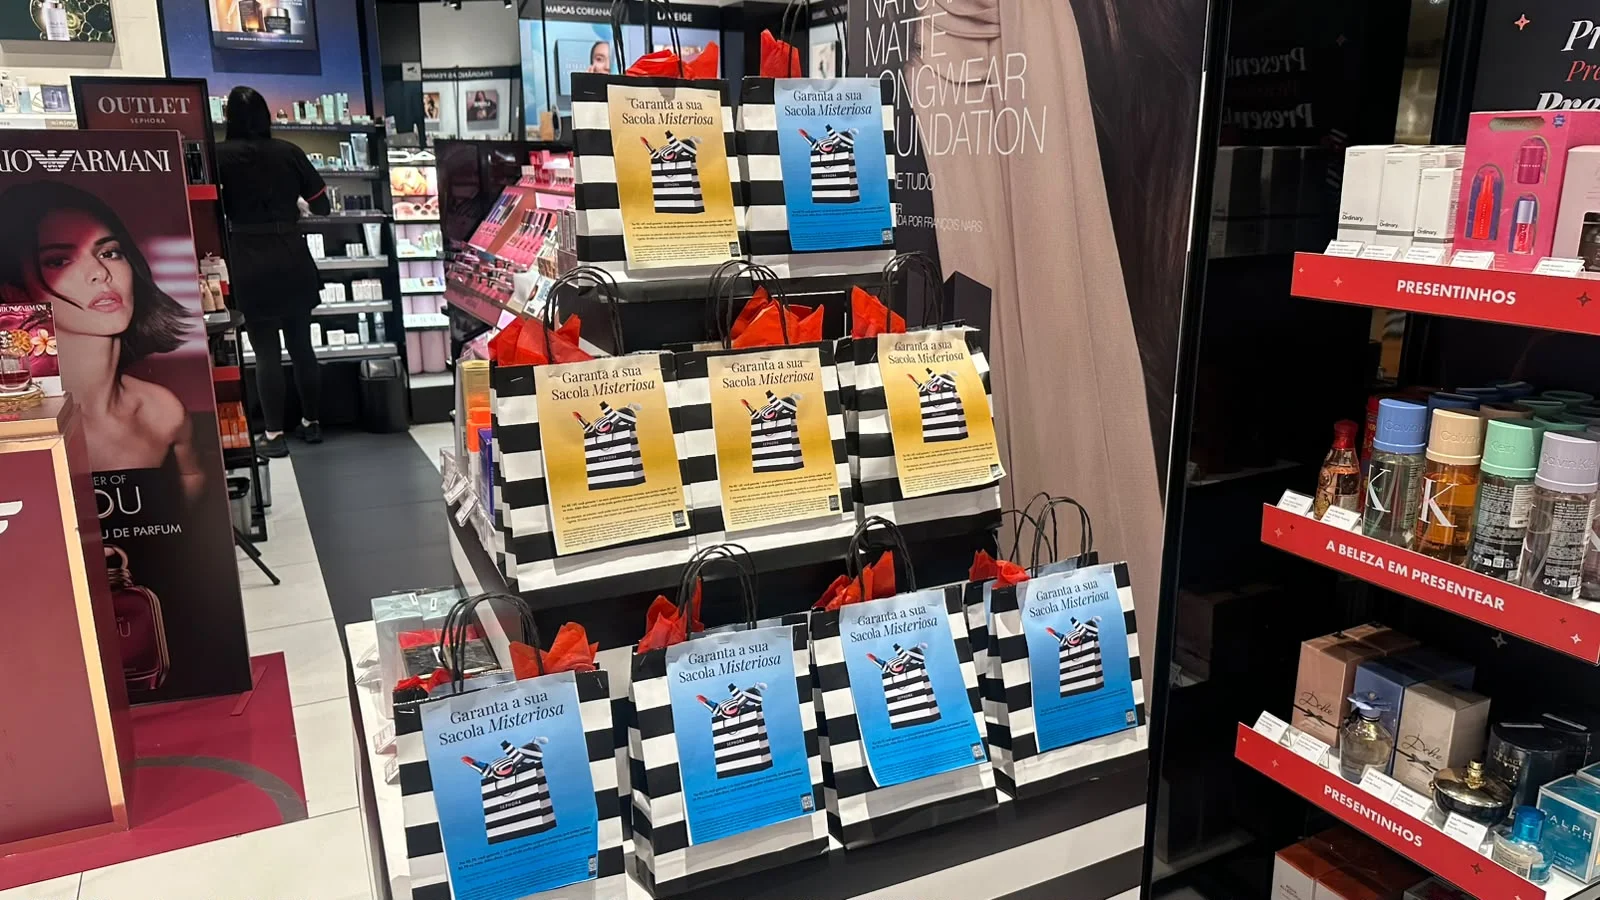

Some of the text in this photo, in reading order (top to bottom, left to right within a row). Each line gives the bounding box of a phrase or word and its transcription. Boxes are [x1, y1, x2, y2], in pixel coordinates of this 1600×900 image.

[545, 5, 612, 17] MARCAS COREANA
[865, 11, 947, 67] MATTE
[865, 52, 1027, 110] ONGWEAR
[98, 96, 190, 114] OUTLET
[630, 98, 703, 111] Garanta a sua
[793, 90, 834, 102] Garanta
[845, 92, 862, 101] sua
[622, 112, 714, 125] Sacola Misteriosa
[784, 104, 872, 117] Sacola Misteriosa
[894, 106, 1047, 157] UNDATION
[70, 149, 171, 172] ARMANI
[905, 172, 936, 191] TUDO
[908, 215, 922, 227] POR
[960, 219, 983, 233] NARS
[1397, 280, 1516, 305] PRESENTINHOS
[894, 341, 929, 351] Garanta
[938, 341, 953, 350] sua
[731, 361, 775, 373] Garanta
[786, 359, 803, 369] sua
[888, 351, 964, 365] Sacola Misteriosa
[562, 367, 642, 384] Garanta a sua
[722, 372, 814, 389] Sacola Misteriosa
[551, 379, 655, 401] Sacola Misteriosa
[110, 474, 127, 485] OF
[1365, 464, 1391, 513] K
[1418, 477, 1458, 528] K
[113, 527, 130, 538] DE
[133, 523, 182, 537] PARFUM
[1326, 540, 1505, 611] A BELEZA EM PRESENTEAR
[1036, 586, 1072, 602] Garanta
[1082, 579, 1099, 592] sua
[857, 609, 897, 626] Garanta
[909, 605, 926, 616] sua
[1029, 590, 1110, 618] Sacola Misteriosa
[850, 617, 938, 643] Sacola Misteriosa
[688, 641, 769, 665] Garanta a sua
[678, 654, 781, 684] Sacola Misteriosa
[450, 691, 549, 724] Garanta a sua
[1299, 690, 1335, 716] Dolce
[439, 703, 565, 746] Sacola Misteriosa
[1401, 733, 1443, 762] Dolce
[1324, 785, 1423, 847] PRESENTINHOS
